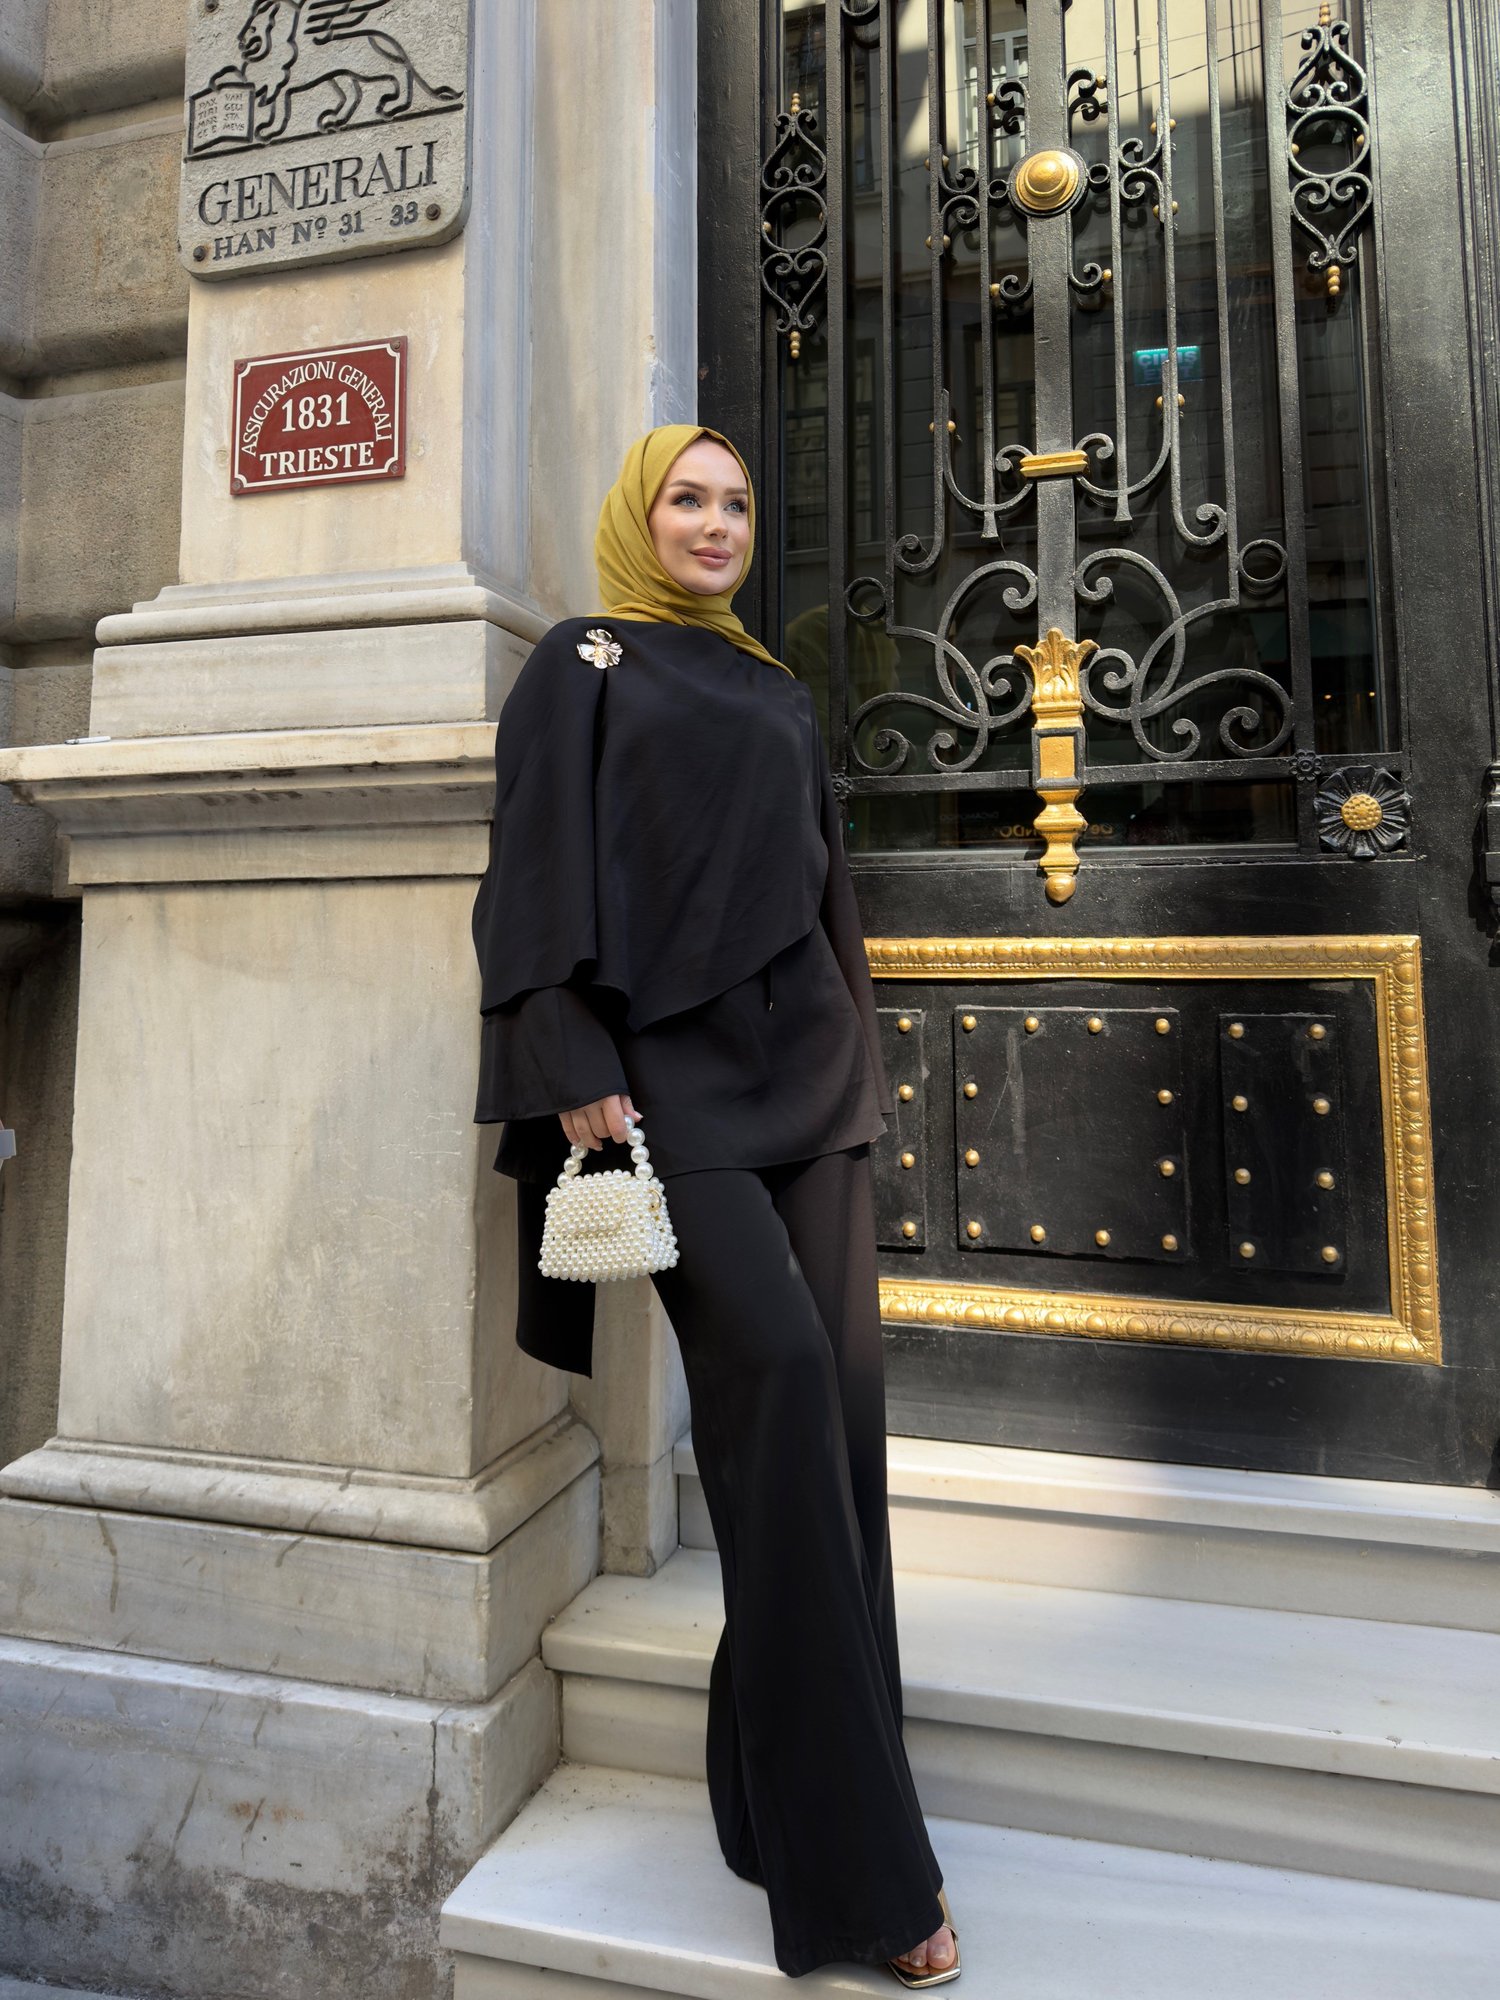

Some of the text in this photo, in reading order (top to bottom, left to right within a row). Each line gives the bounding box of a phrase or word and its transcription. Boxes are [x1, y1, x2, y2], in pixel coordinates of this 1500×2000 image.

[199, 140, 439, 226] GENERALI
[212, 226, 277, 260] HAN
[338, 210, 365, 237] 31
[389, 201, 419, 228] 33
[241, 360, 393, 457] ASSICURAZIONI GENERALI
[281, 391, 351, 432] 1831
[259, 441, 375, 477] TRIESTE
